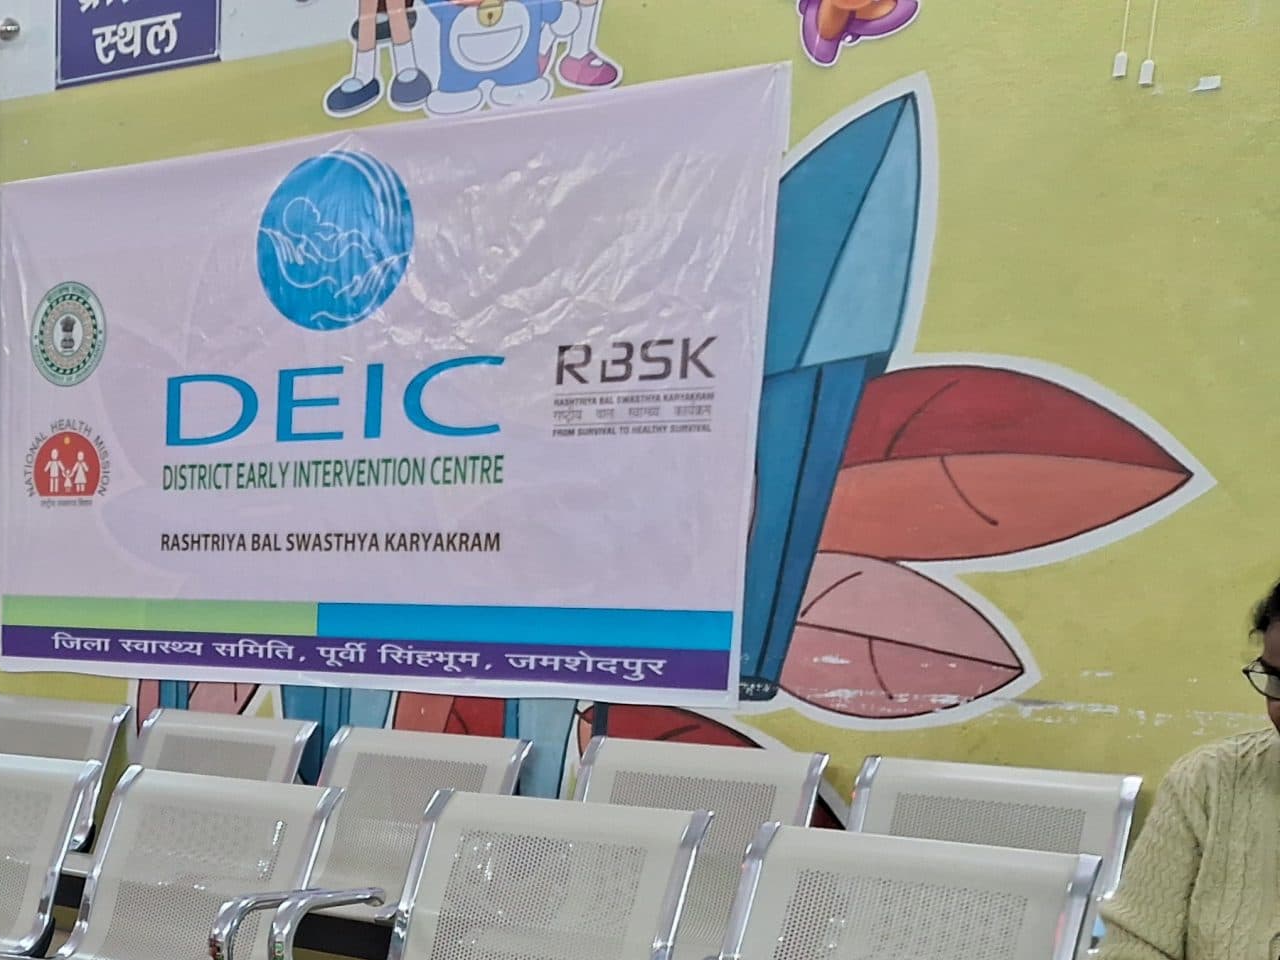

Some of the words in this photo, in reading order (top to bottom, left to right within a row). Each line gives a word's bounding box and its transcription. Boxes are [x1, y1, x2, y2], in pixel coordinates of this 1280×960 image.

[92, 12, 182, 64] स्थल
[555, 335, 718, 385] RBSK
[166, 355, 505, 446] DEIC
[599, 394, 614, 406] BAL
[552, 428, 576, 438] FROM
[577, 426, 617, 437] SURVIVAL
[620, 426, 631, 435] TO
[632, 425, 667, 435] HEALTHY
[670, 423, 712, 434] SURVIVAL
[24, 432, 48, 497] NATIONAL
[50, 418, 93, 437] HEALTH
[93, 435, 111, 496] MISSION
[162, 463, 232, 491] DISTRICT
[236, 461, 291, 489] EARLY
[293, 457, 425, 488] INTERVENTION
[430, 455, 505, 486] CENTRE
[161, 533, 247, 552] RASHTRIYA
[251, 533, 282, 552] BAL
[286, 532, 380, 552] SWASTHYA
[384, 532, 501, 552] KARYAKRAM
[52, 632, 111, 652] जिला
[119, 638, 203, 657] स्वास्थ्य
[315, 642, 367, 668] पूर्वी
[505, 650, 667, 681] जमशेदपुर
